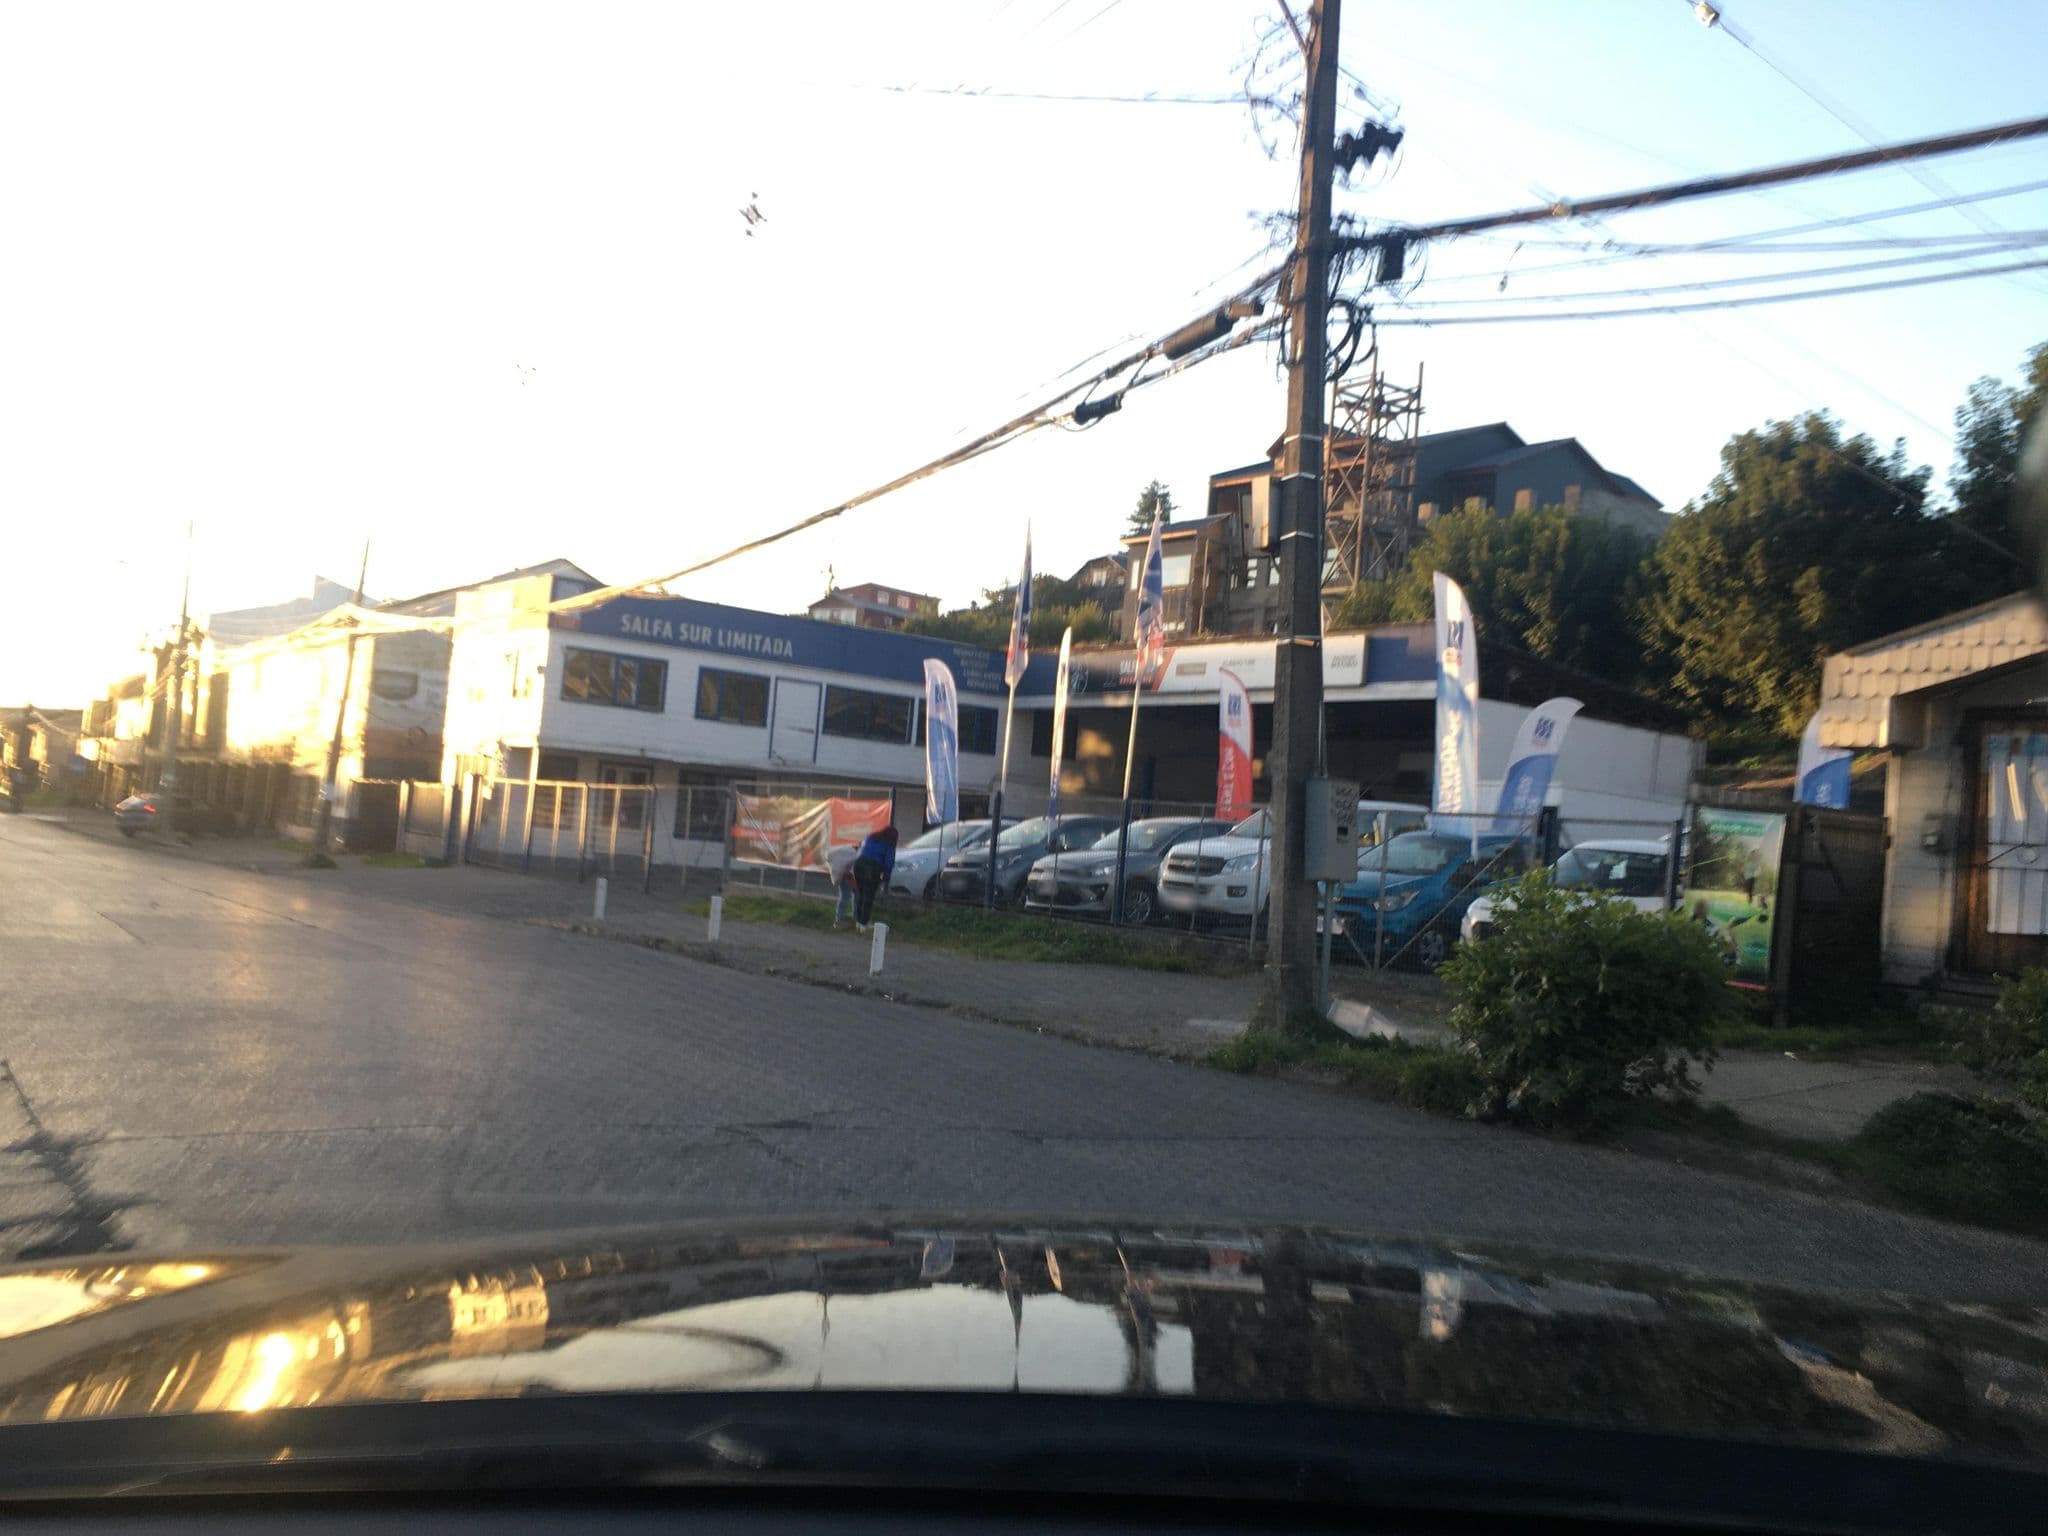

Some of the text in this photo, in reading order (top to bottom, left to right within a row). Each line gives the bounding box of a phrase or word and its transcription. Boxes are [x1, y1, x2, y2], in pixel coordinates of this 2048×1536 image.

[621, 613, 794, 657] SALFA SUR LIMITADA
